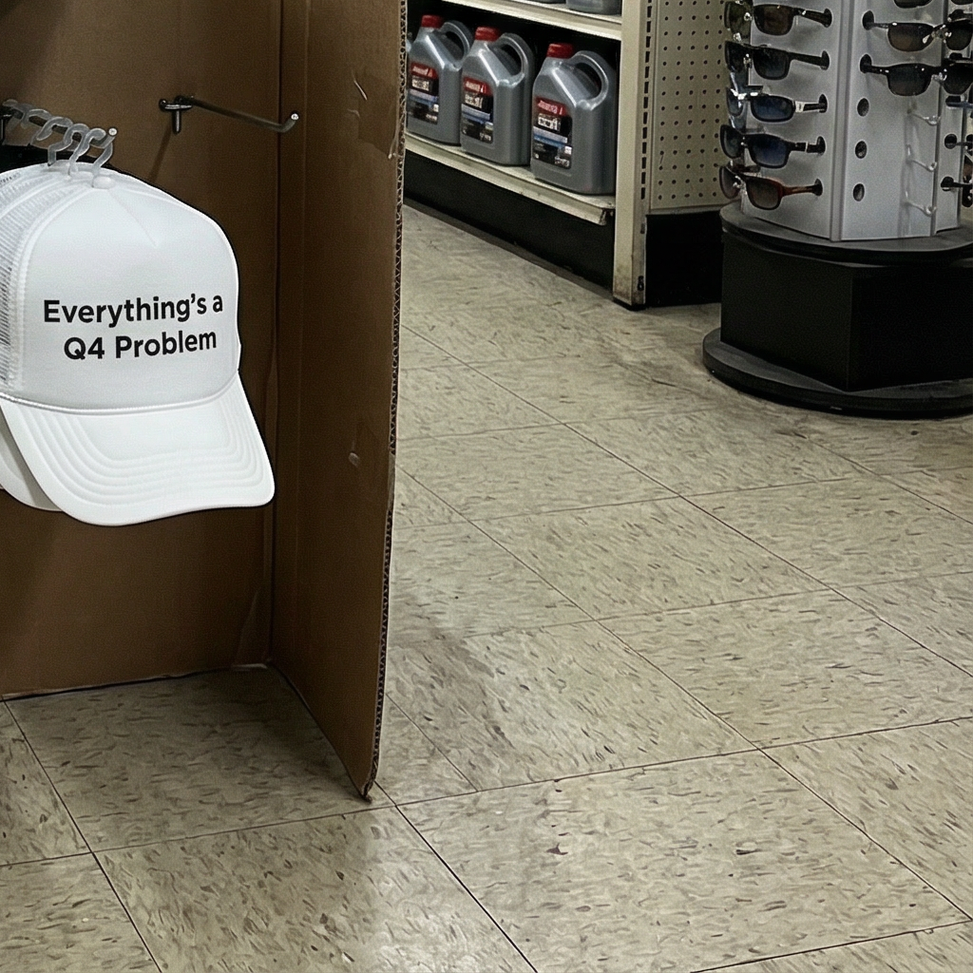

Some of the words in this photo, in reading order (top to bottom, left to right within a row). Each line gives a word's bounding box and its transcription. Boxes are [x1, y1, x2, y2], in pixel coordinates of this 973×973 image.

[43, 293, 207, 329] Everything’s
[212, 294, 223, 313] a
[63, 336, 106, 361] Q4
[115, 329, 217, 359] Problem
